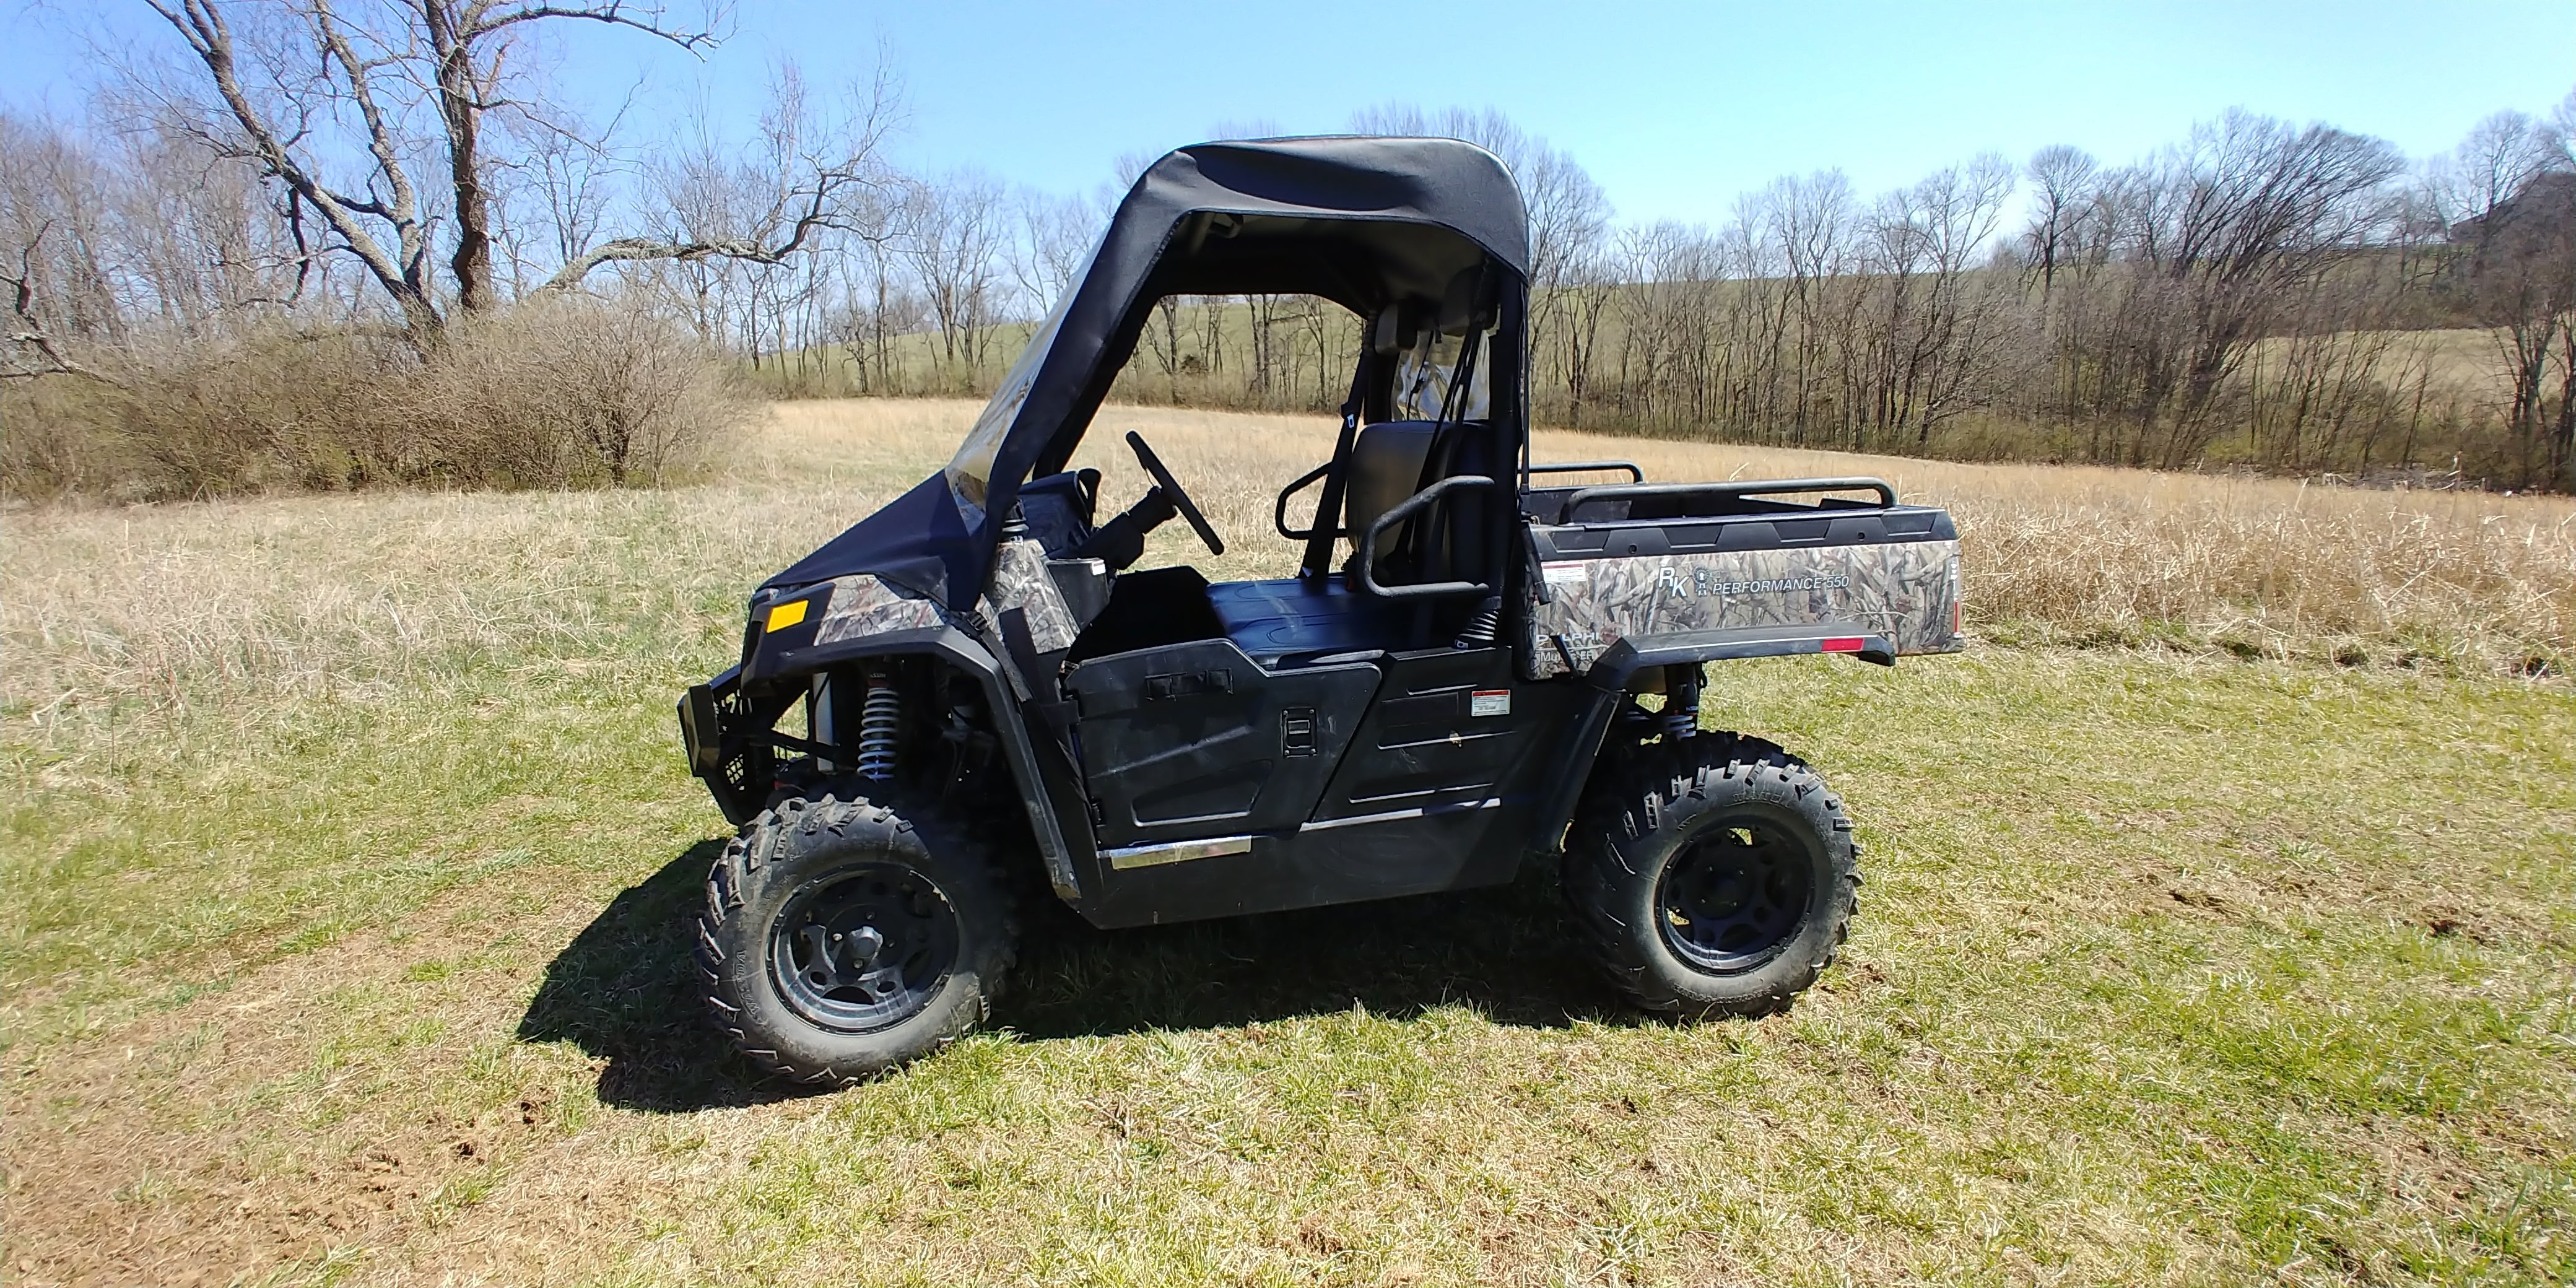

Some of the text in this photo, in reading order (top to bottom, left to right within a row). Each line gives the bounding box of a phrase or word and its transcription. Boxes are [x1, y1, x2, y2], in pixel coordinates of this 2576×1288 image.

[1712, 575, 1850, 595] PERFORMANCE 550
[1536, 632, 1599, 642] DLPHI
